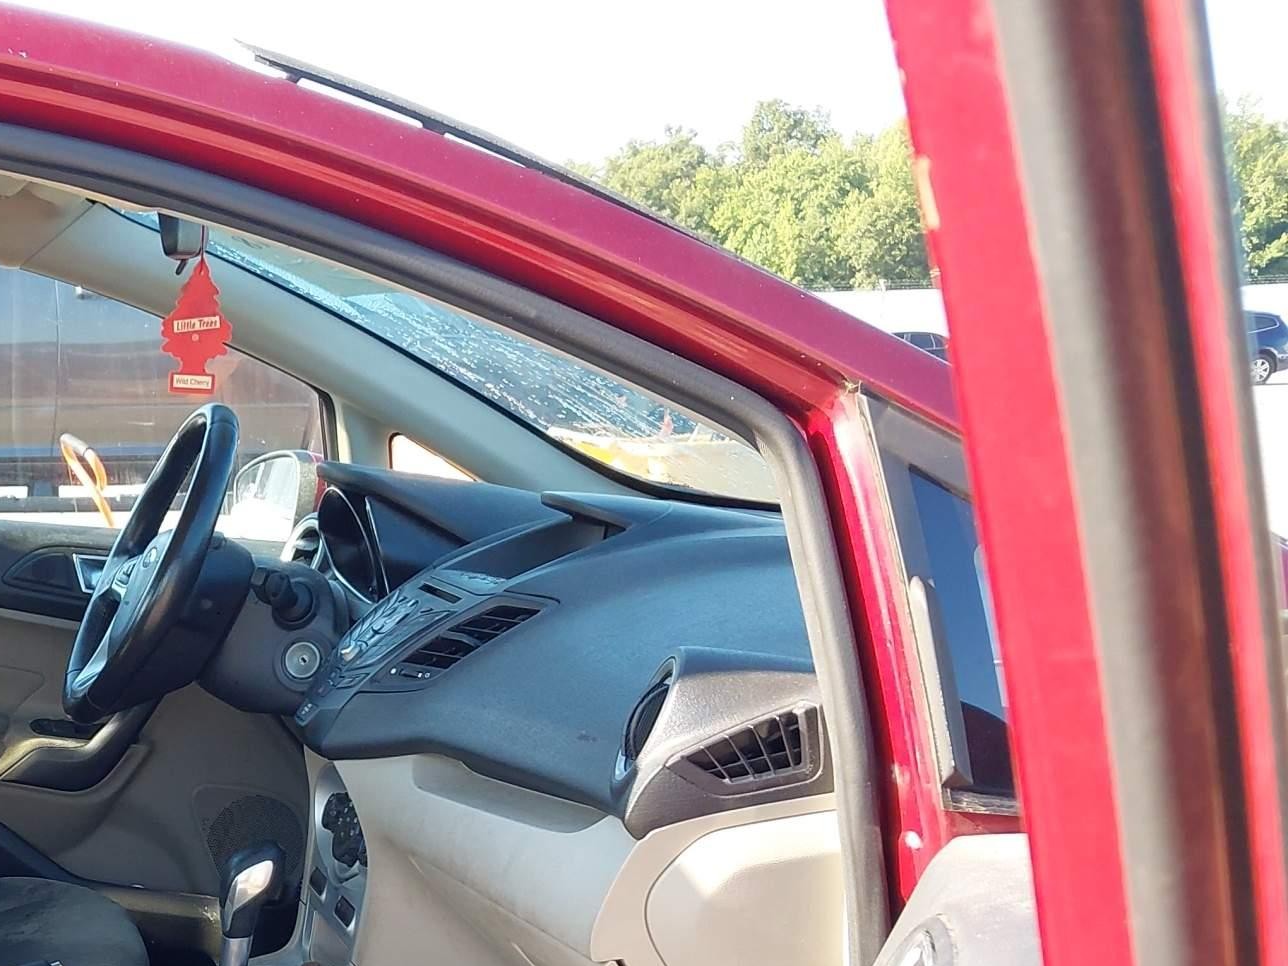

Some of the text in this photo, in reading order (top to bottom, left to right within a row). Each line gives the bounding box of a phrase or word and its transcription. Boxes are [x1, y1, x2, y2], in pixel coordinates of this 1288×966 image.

[176, 318, 218, 331] Little Trees
[175, 377, 210, 388] Wild Cherry
